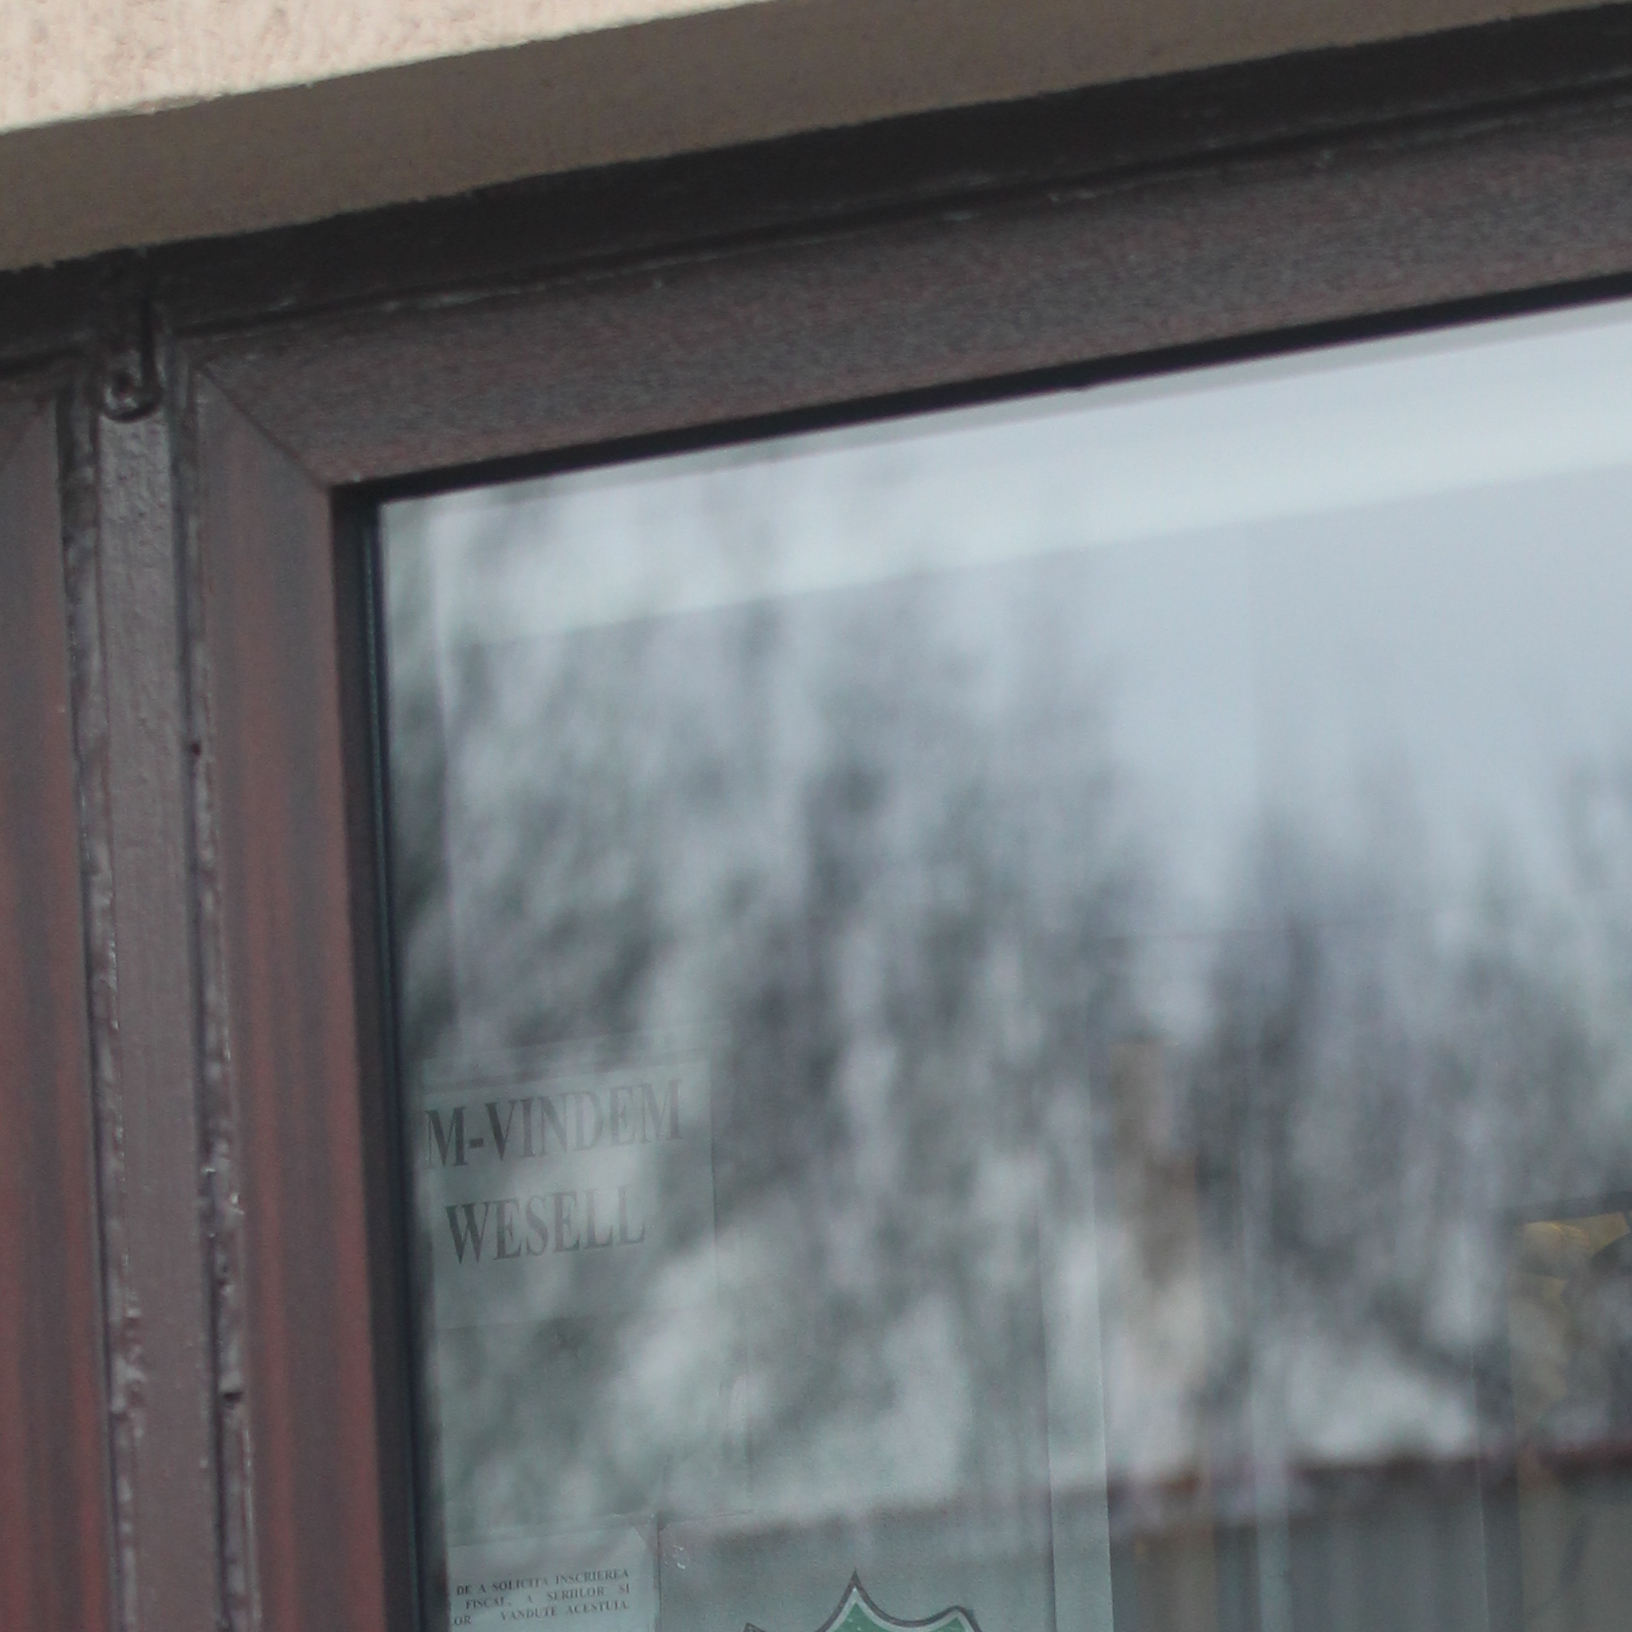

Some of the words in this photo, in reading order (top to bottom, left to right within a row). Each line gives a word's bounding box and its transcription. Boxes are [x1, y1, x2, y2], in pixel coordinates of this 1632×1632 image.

[456, 1584, 473, 1596] DE
[479, 1583, 487, 1594] A
[492, 1578, 550, 1592] SOLICITA
[555, 1568, 630, 1585] INSCRIEREA
[618, 1583, 631, 1595] SI
[452, 1615, 472, 1626] OR
[501, 1606, 557, 1621] VANDUTE
